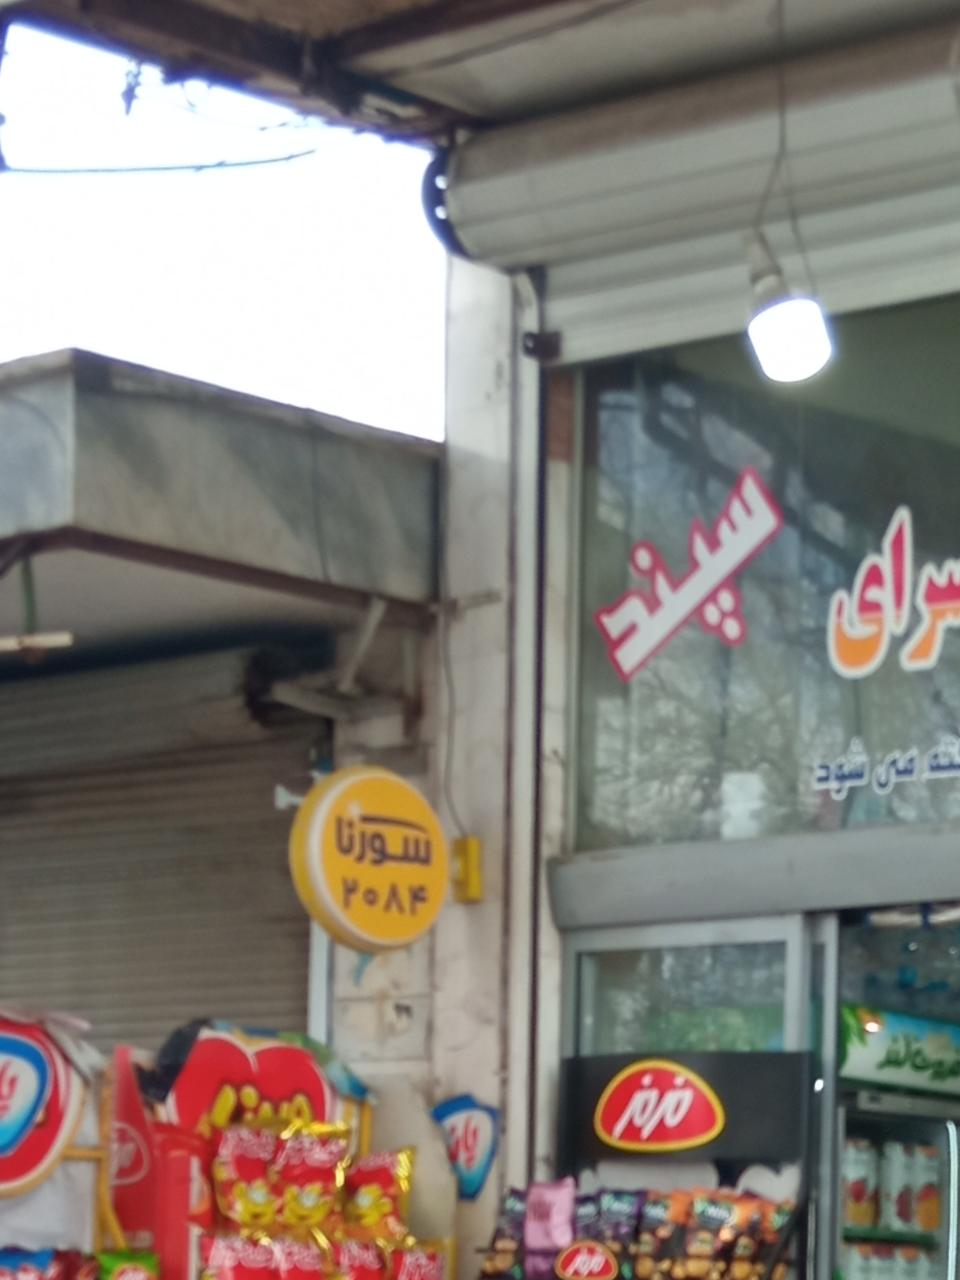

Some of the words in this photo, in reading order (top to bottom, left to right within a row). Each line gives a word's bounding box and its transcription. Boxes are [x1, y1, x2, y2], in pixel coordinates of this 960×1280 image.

[594, 465, 784, 683] سپند
[813, 736, 870, 800] شود
[335, 804, 432, 866] سورنا
[342, 878, 429, 916] ۲۰۸۴
[611, 1073, 694, 1141] مزمز
